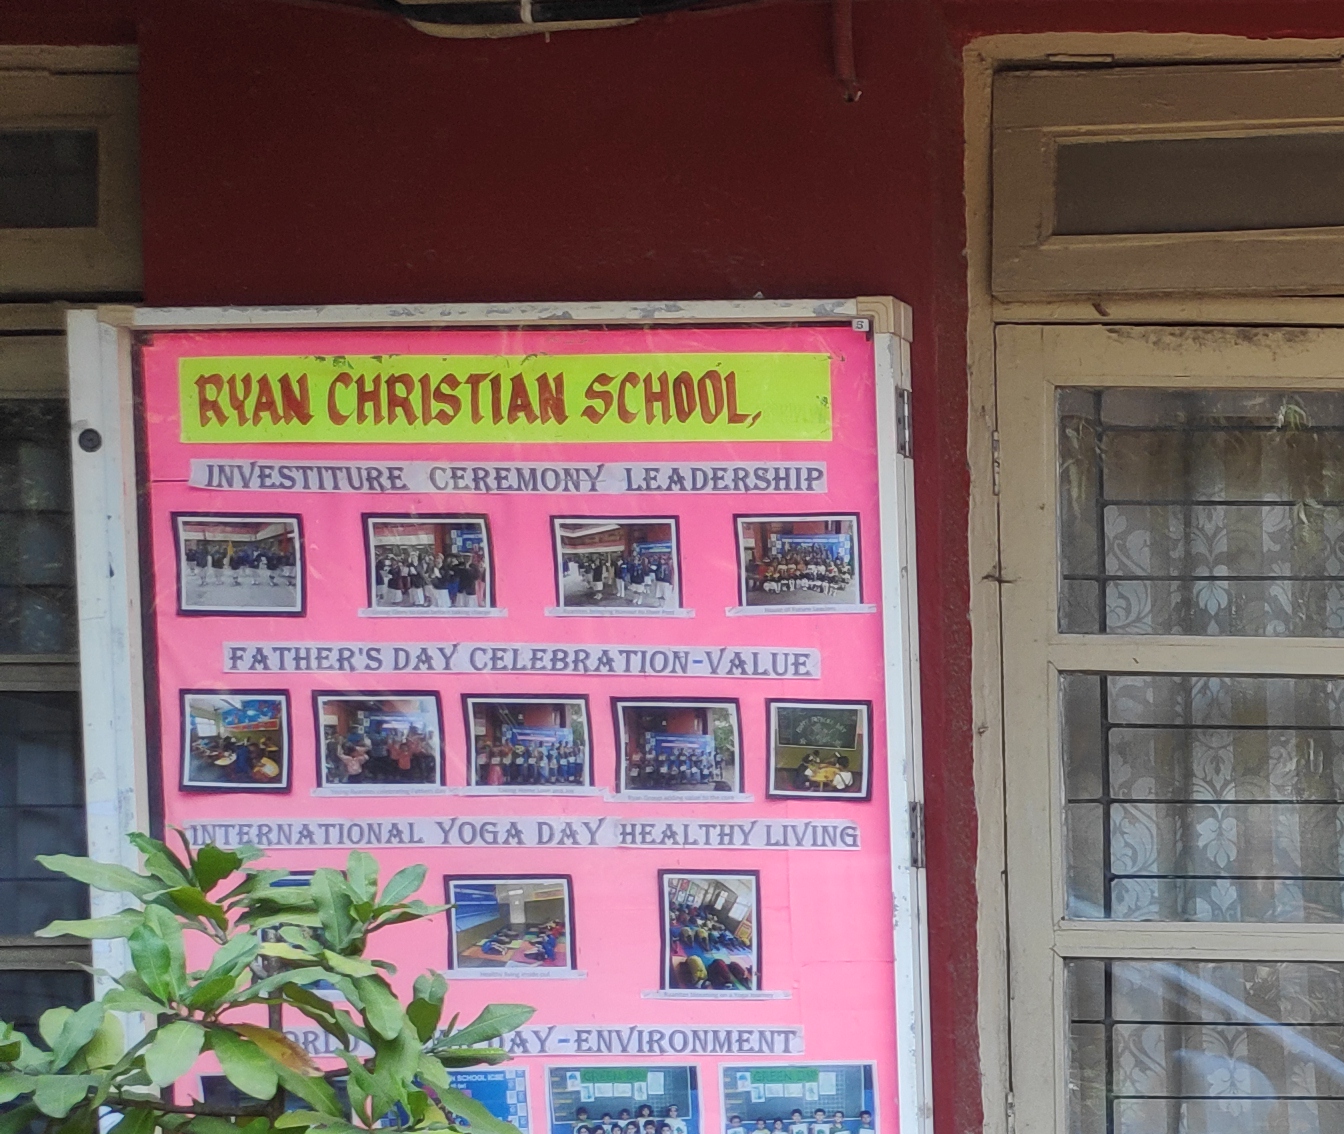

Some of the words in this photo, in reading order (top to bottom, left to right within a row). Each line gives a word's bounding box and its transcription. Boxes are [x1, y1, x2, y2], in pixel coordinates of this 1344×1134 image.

[194, 372, 314, 427] RYAN
[327, 370, 568, 426] CHRISTIAN
[580, 370, 762, 428] SCHOOL,
[204, 461, 409, 492] INVESTITURE
[429, 463, 605, 492] CEREMONY
[624, 467, 824, 493] LEADERSHIP
[229, 647, 383, 672] FATHER'S
[392, 643, 460, 671] DAY
[469, 646, 813, 677] CELEBRATION-VALUE
[190, 822, 425, 846] INTERNATIONAL
[435, 817, 525, 846] YOGA
[536, 817, 606, 846] DAY
[619, 820, 759, 847] HEALTHY
[764, 821, 859, 848] LIVING
